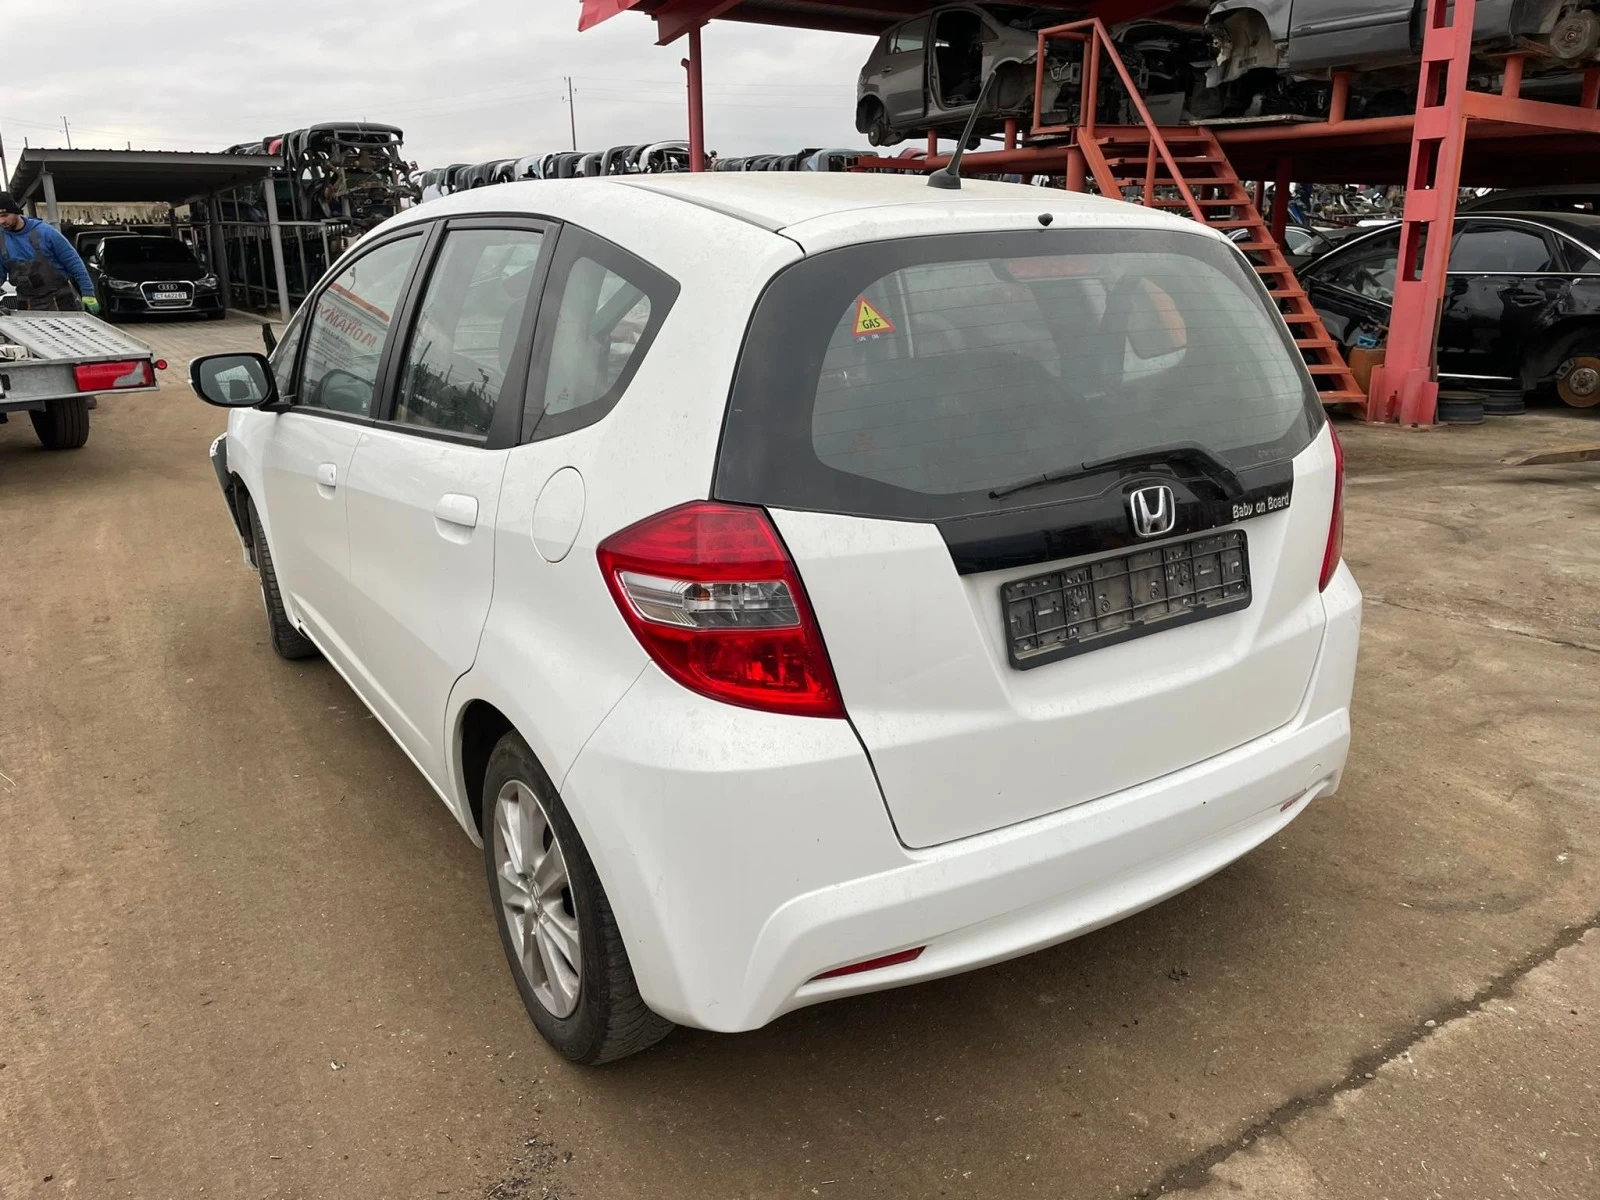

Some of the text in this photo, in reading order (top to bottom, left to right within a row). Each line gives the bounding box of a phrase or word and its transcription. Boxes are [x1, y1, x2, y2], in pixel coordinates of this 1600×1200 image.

[862, 318, 881, 330] GAS
[1232, 492, 1289, 519] Baby on Board
